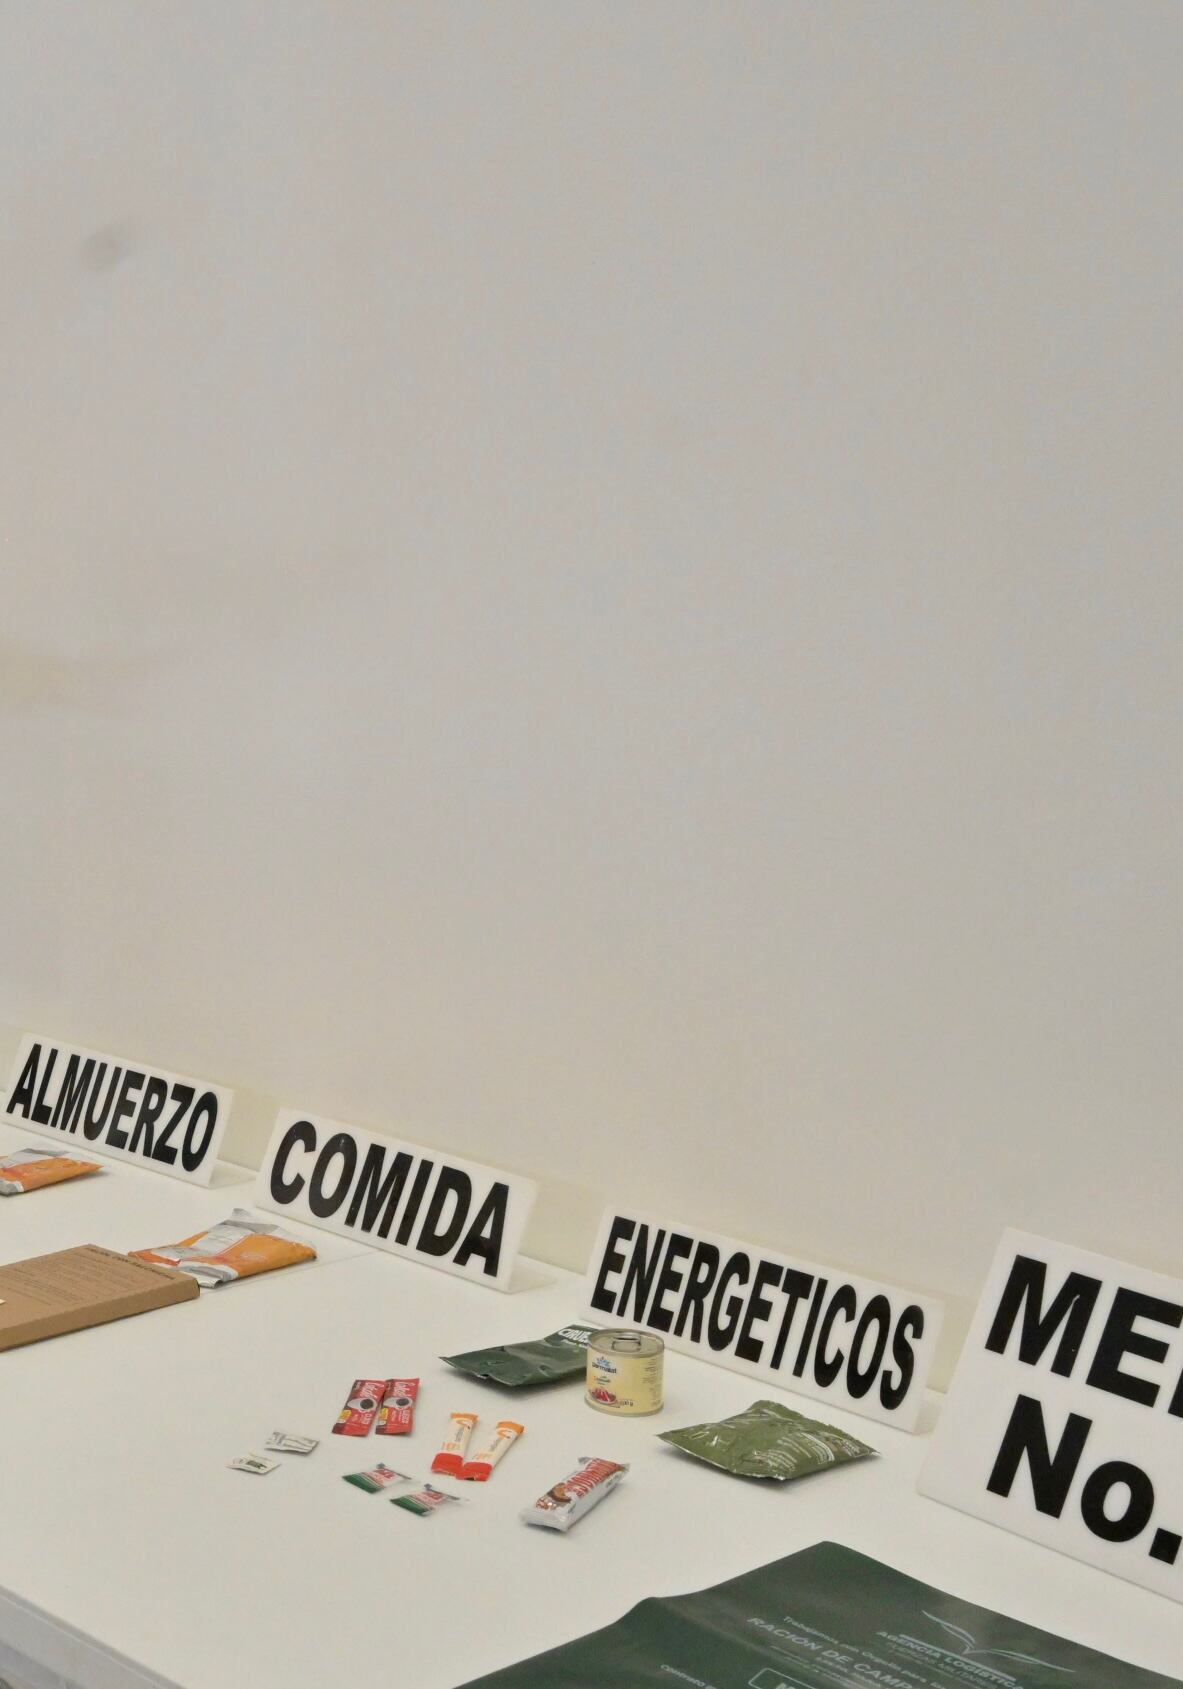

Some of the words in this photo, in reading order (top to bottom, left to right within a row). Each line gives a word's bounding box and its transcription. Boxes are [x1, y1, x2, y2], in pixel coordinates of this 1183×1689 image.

[7, 1044, 217, 1171] ALMUERZO
[271, 1121, 508, 1277] COMIDA
[591, 1216, 923, 1410] ENERGETICOS
[985, 1255, 1183, 1418] ME
[987, 1394, 1182, 1564] No.
[747, 1617, 822, 1651] RACIÓN
[821, 1649, 853, 1664] DE
[876, 1631, 942, 1658] AGENCIA
